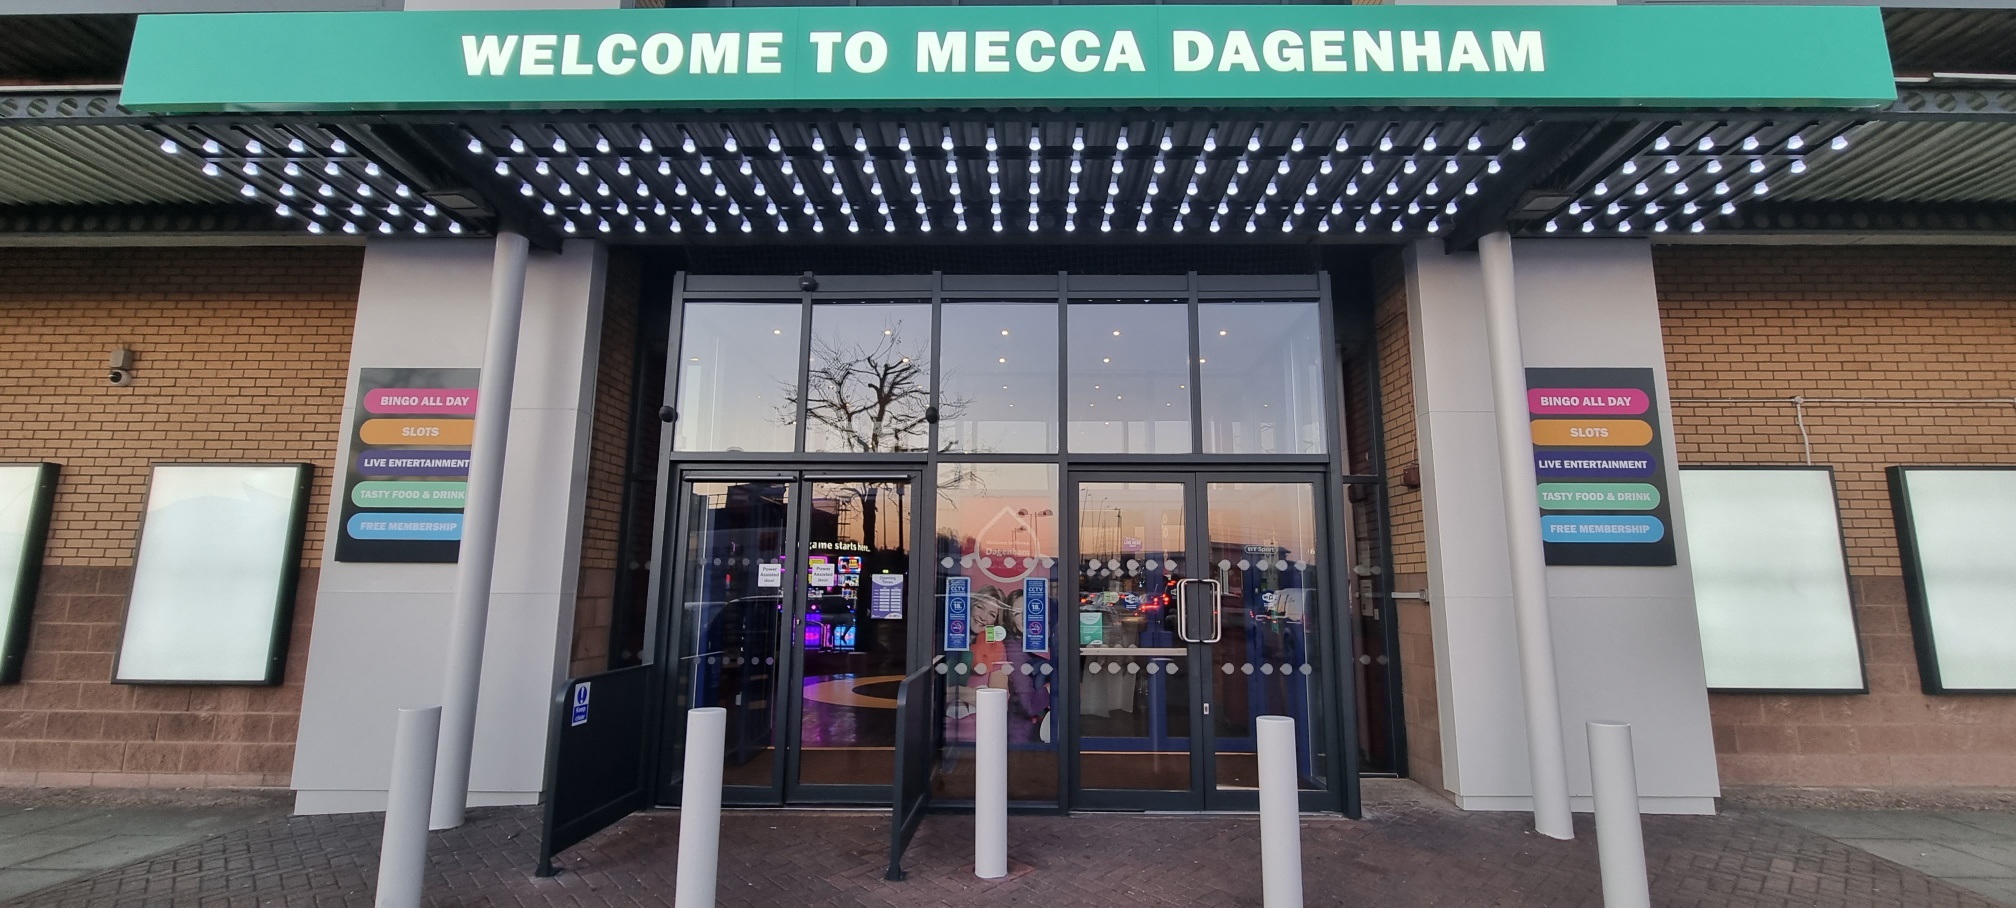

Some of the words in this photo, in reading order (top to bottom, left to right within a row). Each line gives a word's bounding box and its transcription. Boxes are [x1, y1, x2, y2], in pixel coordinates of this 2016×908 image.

[461, 33, 783, 76] WELCOME
[809, 31, 888, 74] TO
[916, 30, 1146, 73] MECCA
[1170, 30, 1546, 73] DAGENHAM
[380, 396, 418, 406] BINGO
[421, 396, 443, 406] ALL
[446, 396, 470, 406] DAY
[1540, 396, 1580, 407] BINGO
[1582, 396, 1606, 407] ALL
[1608, 396, 1632, 407] DAY
[402, 427, 439, 437] SLOTS
[1570, 427, 1609, 438] SLOTS
[364, 459, 386, 468] LIVE
[388, 459, 470, 468] ENTERTAINMENT
[1538, 460, 1562, 469] LIVE
[1564, 460, 1648, 469] ENTERTAINMENT
[360, 490, 392, 499] TASTY
[392, 490, 420, 499] FOOD
[422, 490, 430, 499] &
[433, 490, 465, 499] DRINK
[1542, 492, 1573, 501] TASTY
[1575, 492, 1604, 501] FOOD
[1606, 492, 1616, 501] &
[1617, 492, 1651, 501] DRINK
[360, 522, 386, 531] FREE
[388, 521, 457, 531] MEMBERSHIP
[1550, 524, 1577, 534] FREE
[1580, 524, 1650, 534] MEMBERSHIP
[835, 541, 857, 551] starts
